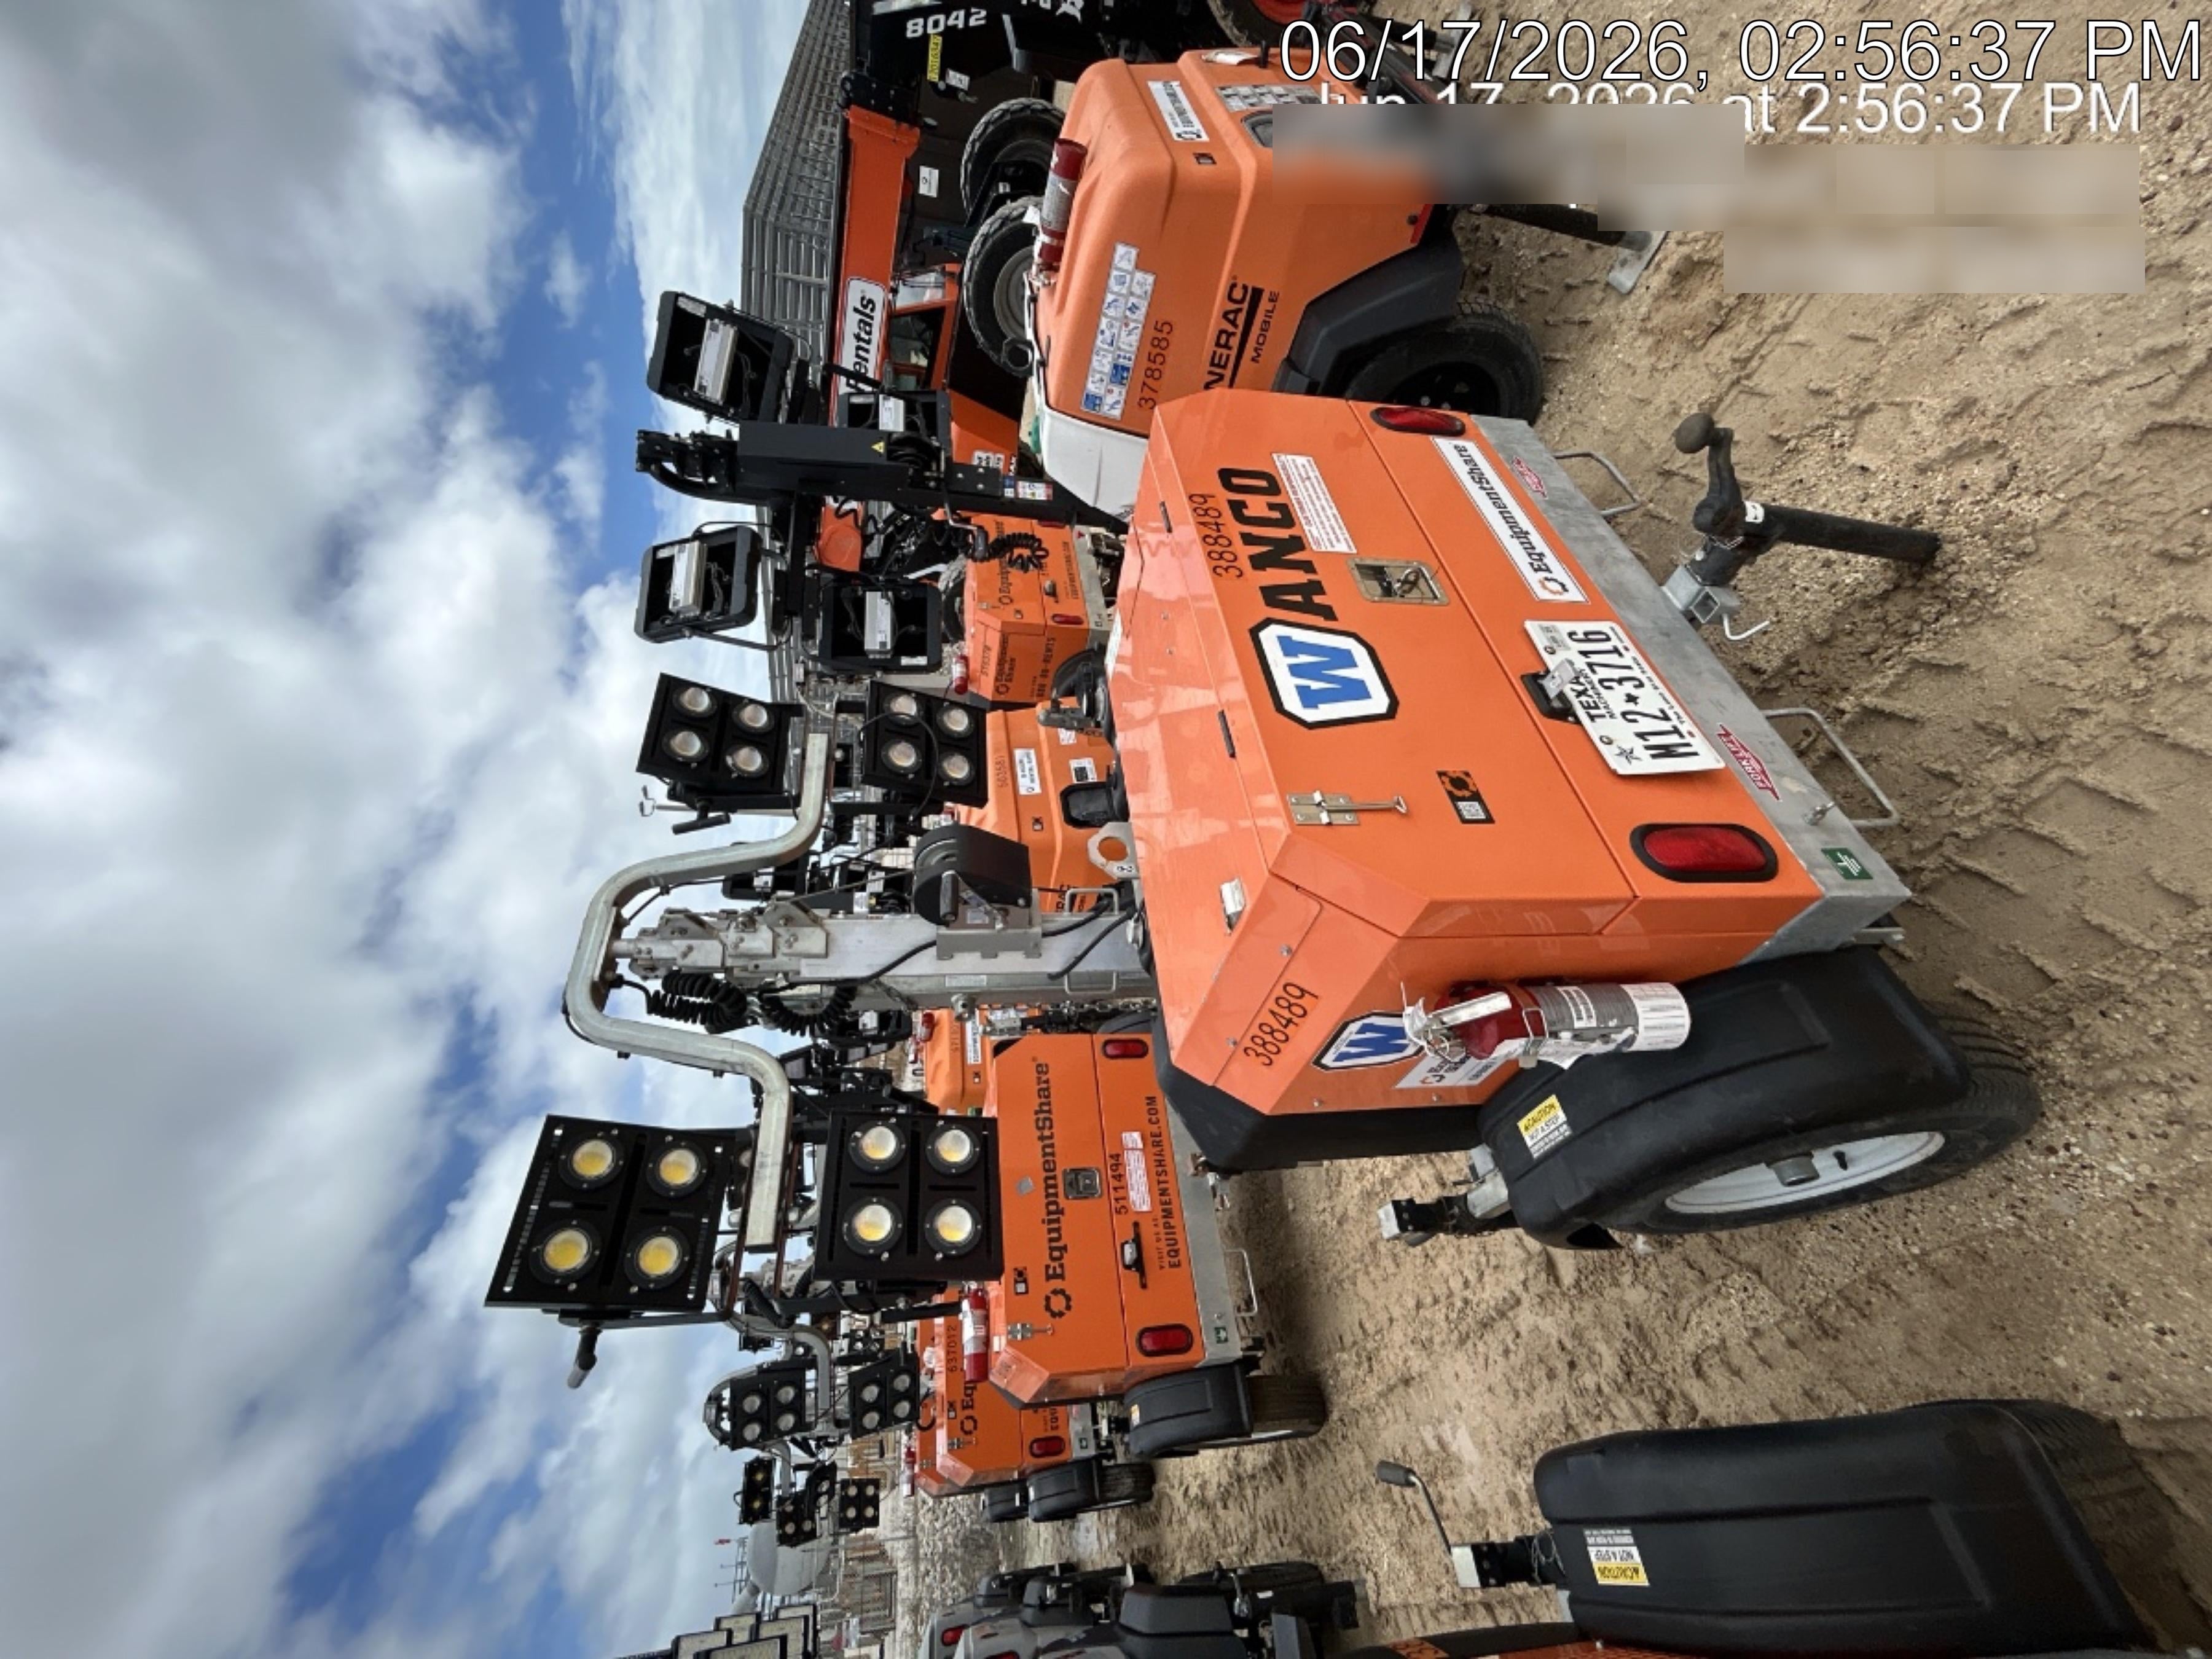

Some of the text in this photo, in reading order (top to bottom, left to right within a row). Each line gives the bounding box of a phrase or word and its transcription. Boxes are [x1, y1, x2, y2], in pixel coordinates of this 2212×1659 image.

[906, 8, 987, 38] 8042
[1137, 321, 1173, 410] 378585
[1203, 283, 1249, 390] NERAC
[1251, 291, 1280, 363] MOBILE
[1188, 493, 1244, 579] 388489
[1453, 444, 1553, 574] EquipmentShare
[1568, 675, 1606, 723] TEXA
[1741, 758, 1765, 788] FORK
[1243, 981, 1319, 1066] 388489
[1332, 1022, 1410, 1062] W
[1034, 1062, 1067, 1282] EquipmentShare
[1108, 1153, 1129, 1215] 511494
[1145, 1096, 1182, 1268] EQUIPMENTSHARE.COM
[947, 1324, 958, 1373] 637012
